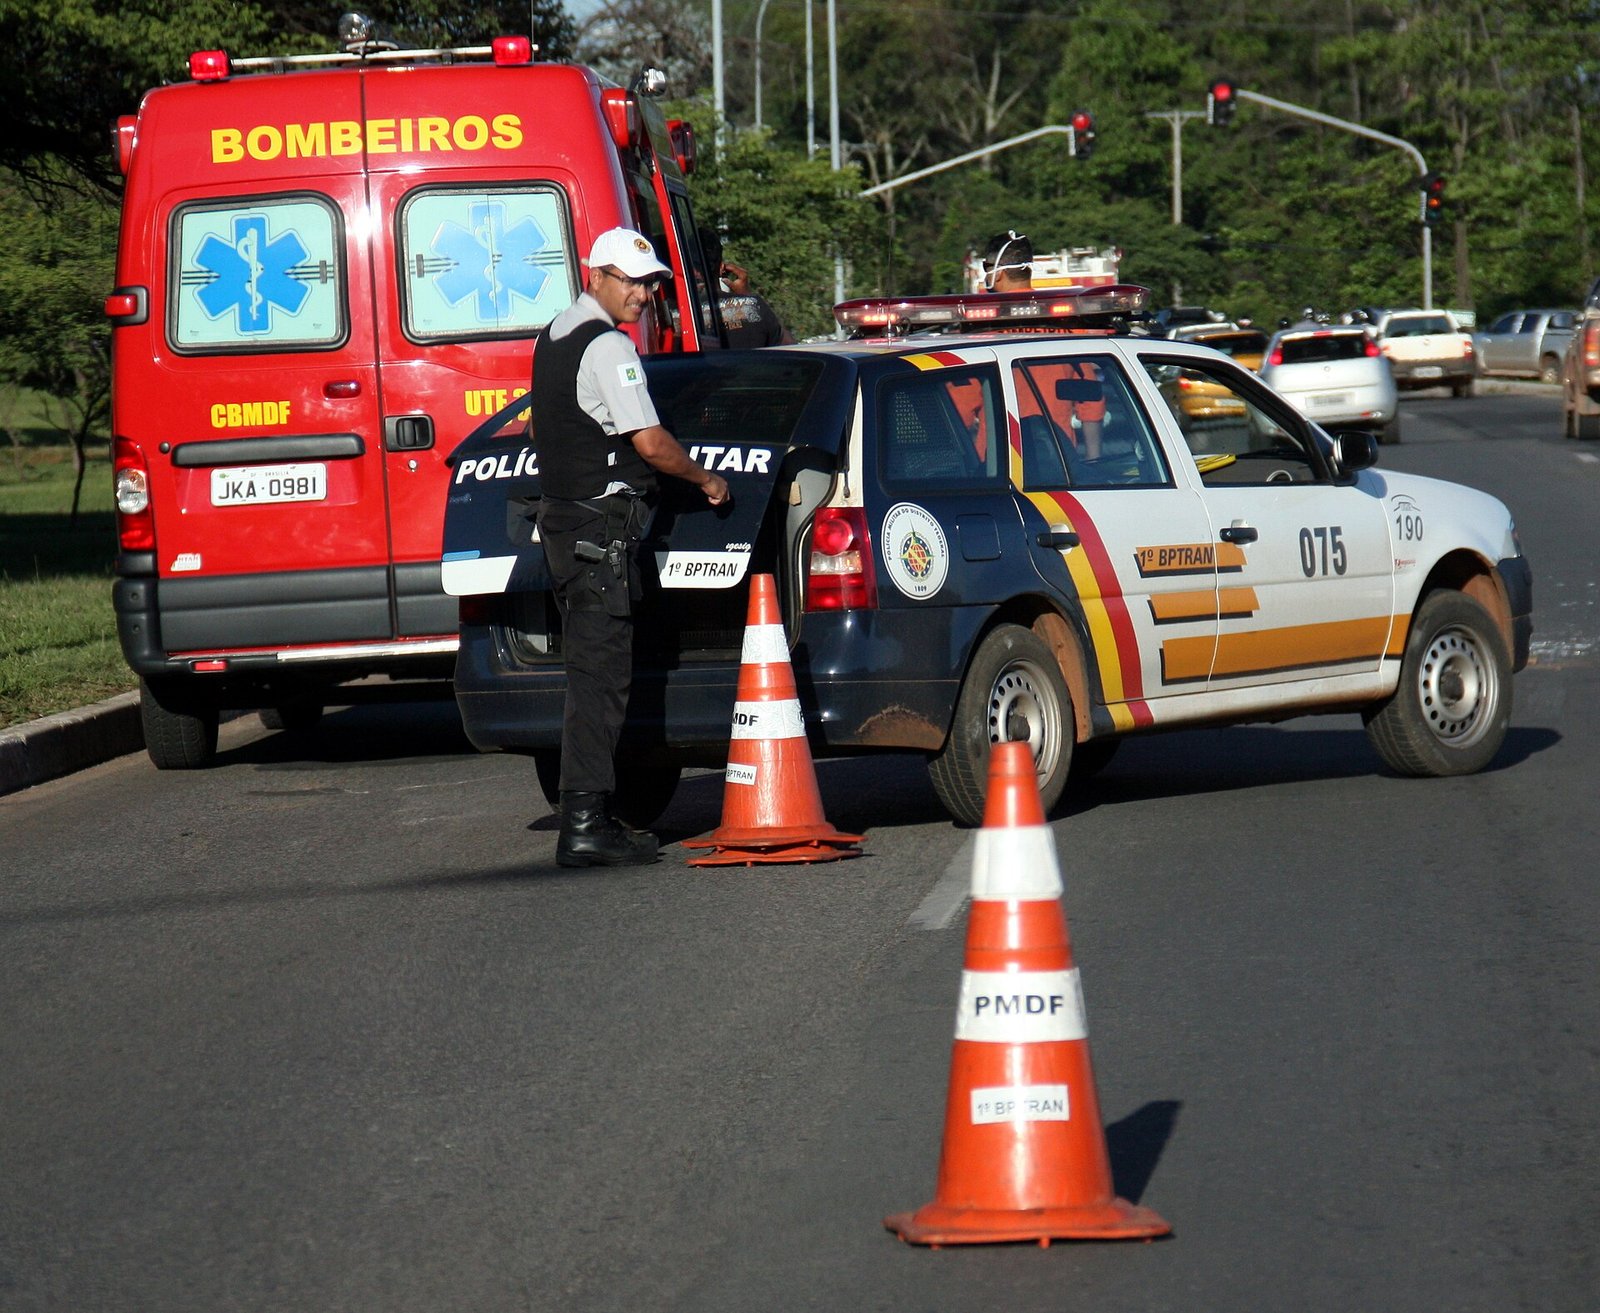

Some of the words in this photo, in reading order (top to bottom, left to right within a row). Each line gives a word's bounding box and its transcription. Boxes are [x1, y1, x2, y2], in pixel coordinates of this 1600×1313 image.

[211, 114, 524, 163] BOMBEIROS
[210, 401, 291, 428] CBMDF
[455, 447, 539, 484] POLÍC
[689, 446, 772, 473] ITAR
[1396, 514, 1423, 541] 190
[1158, 546, 1215, 566] BPTRAN
[1300, 526, 1347, 577] 075
[684, 562, 738, 577] BPTRAN
[975, 995, 1064, 1016] PMDF
